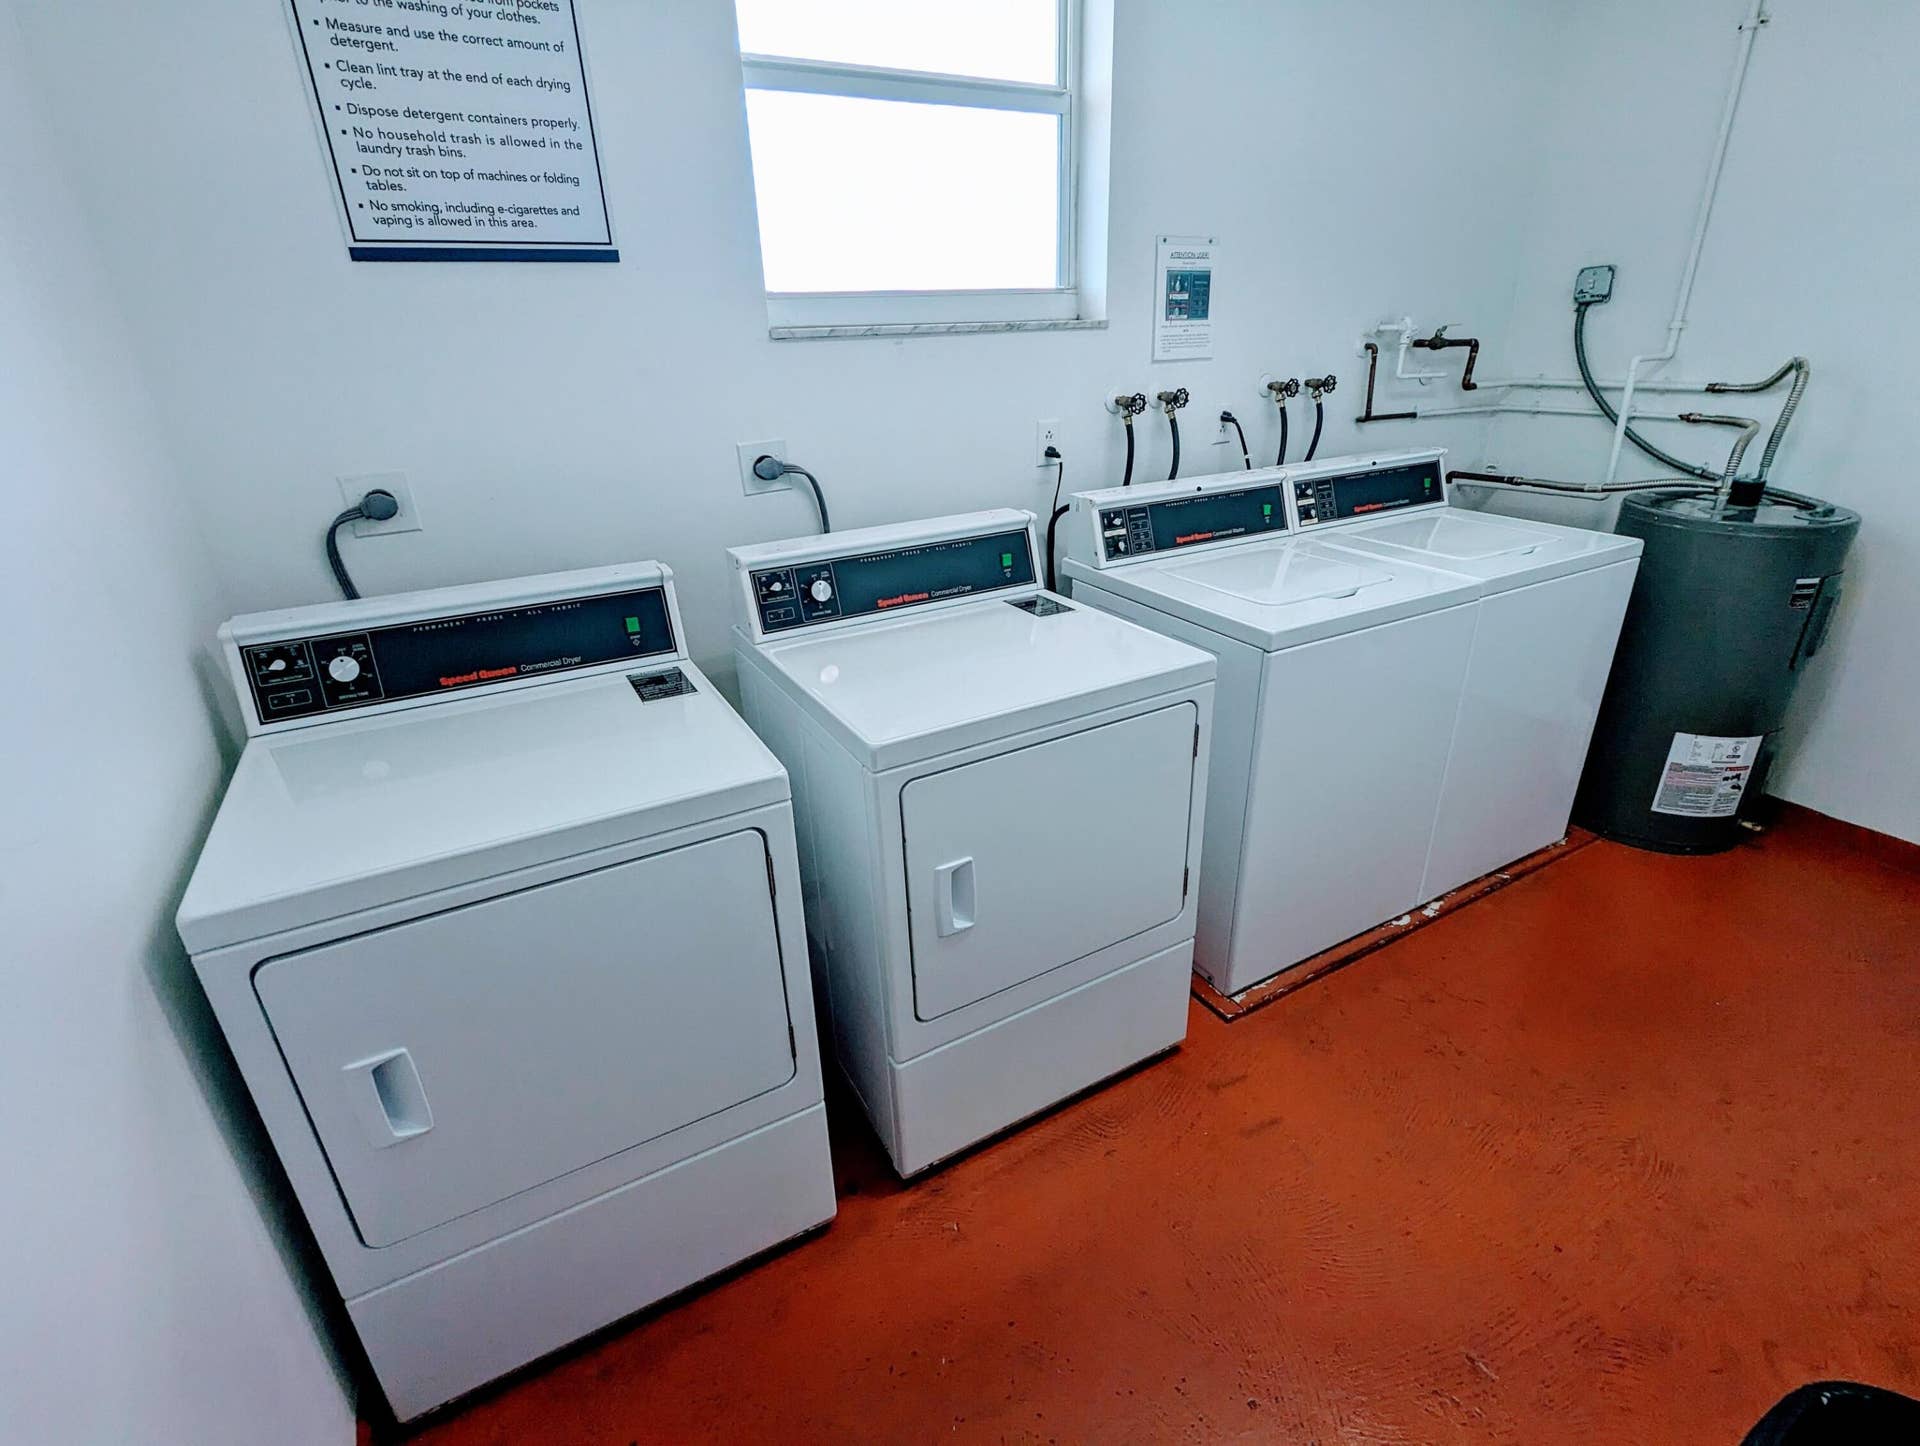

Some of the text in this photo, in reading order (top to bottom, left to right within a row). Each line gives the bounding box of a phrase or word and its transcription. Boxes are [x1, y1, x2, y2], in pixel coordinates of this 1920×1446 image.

[374, 0, 393, 8] the
[397, 0, 447, 17] washing
[451, 4, 463, 16] of
[467, 9, 492, 20] your
[496, 9, 541, 24] clothes.
[517, 0, 559, 12] pockets
[325, 17, 565, 52] Measure and use the correct amount of
[330, 33, 399, 52] detergent.
[336, 59, 571, 94] Clean lint tray at the end of each drying
[340, 77, 377, 91] cycle.
[347, 102, 581, 132] Dispose detergent containers properly.
[353, 126, 583, 150] No household trash is allowed in the
[356, 141, 466, 158] laundry trash bins.
[362, 164, 580, 187] Do not sit on top of machines or folding
[366, 179, 407, 192] tables.
[369, 199, 580, 217] No smoking, including e-cigarettes and
[373, 215, 538, 229] vaping is allowed in this area.
[877, 594, 903, 608] Speed
[930, 587, 959, 597] Commercial
[413, 620, 465, 632] PERMANENT
[440, 656, 582, 687] Speed Queen Commercial Dryer
